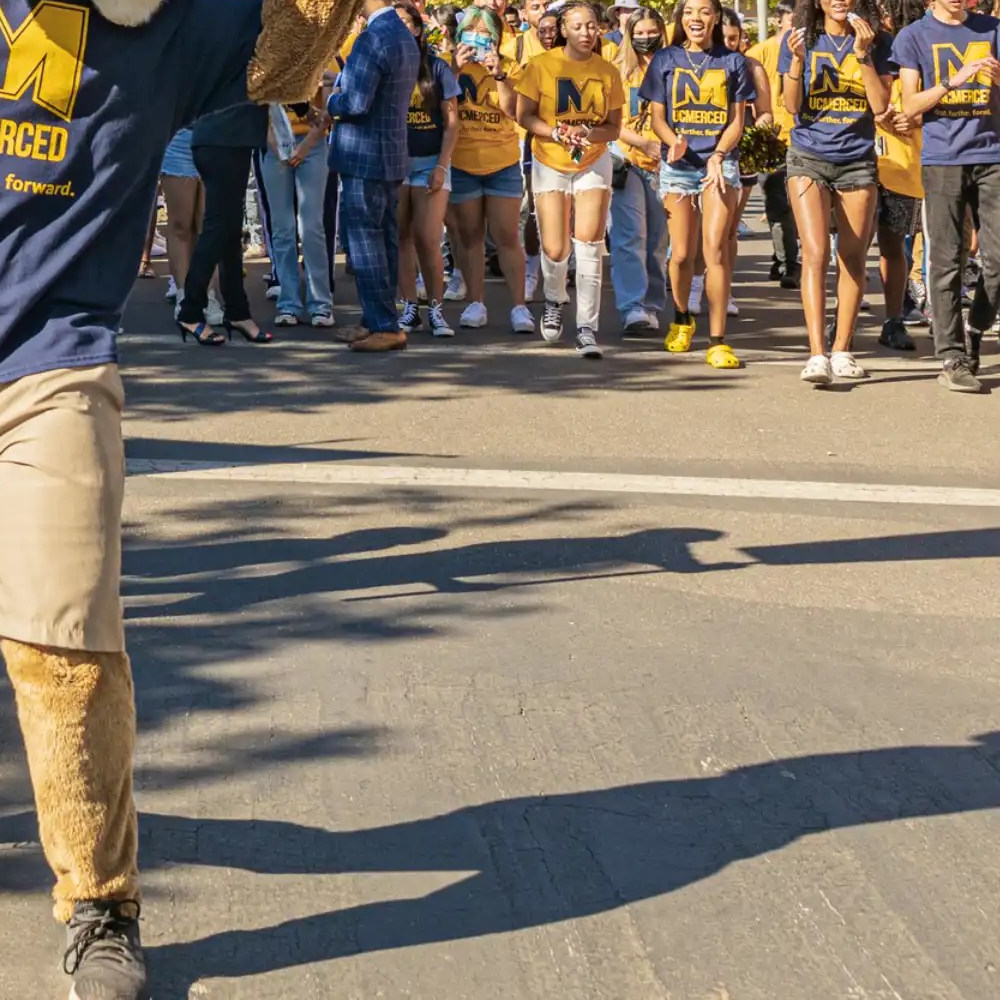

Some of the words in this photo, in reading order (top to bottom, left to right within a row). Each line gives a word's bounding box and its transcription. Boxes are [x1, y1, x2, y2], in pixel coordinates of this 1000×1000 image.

[672, 67, 728, 111] M
[808, 96, 868, 112] UCMERCED
[672, 108, 728, 125] UCMERCED
[5, 173, 75, 197] forward.
